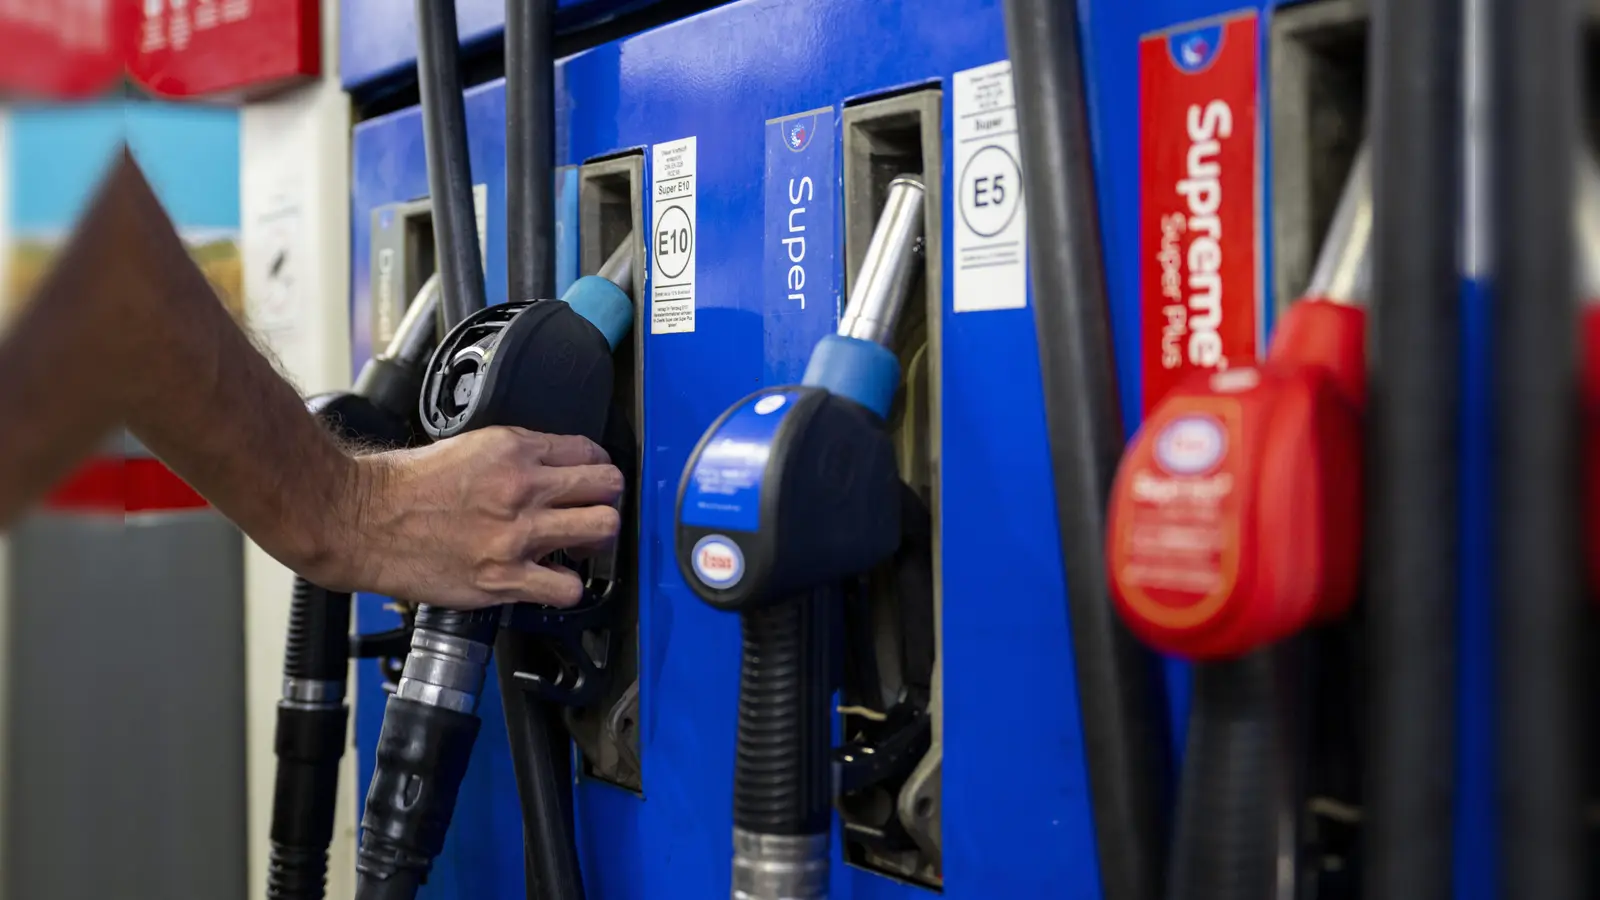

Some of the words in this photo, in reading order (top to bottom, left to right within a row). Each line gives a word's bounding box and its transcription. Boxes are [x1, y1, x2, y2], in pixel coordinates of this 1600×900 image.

[658, 184, 677, 196] Super
[678, 180, 690, 192] E10
[974, 174, 1005, 208] E5
[658, 227, 688, 256] E10
[782, 176, 813, 310] Super
[1156, 212, 1187, 302] Super
[1175, 99, 1233, 367] Supreme
[1162, 305, 1187, 369] Plus
